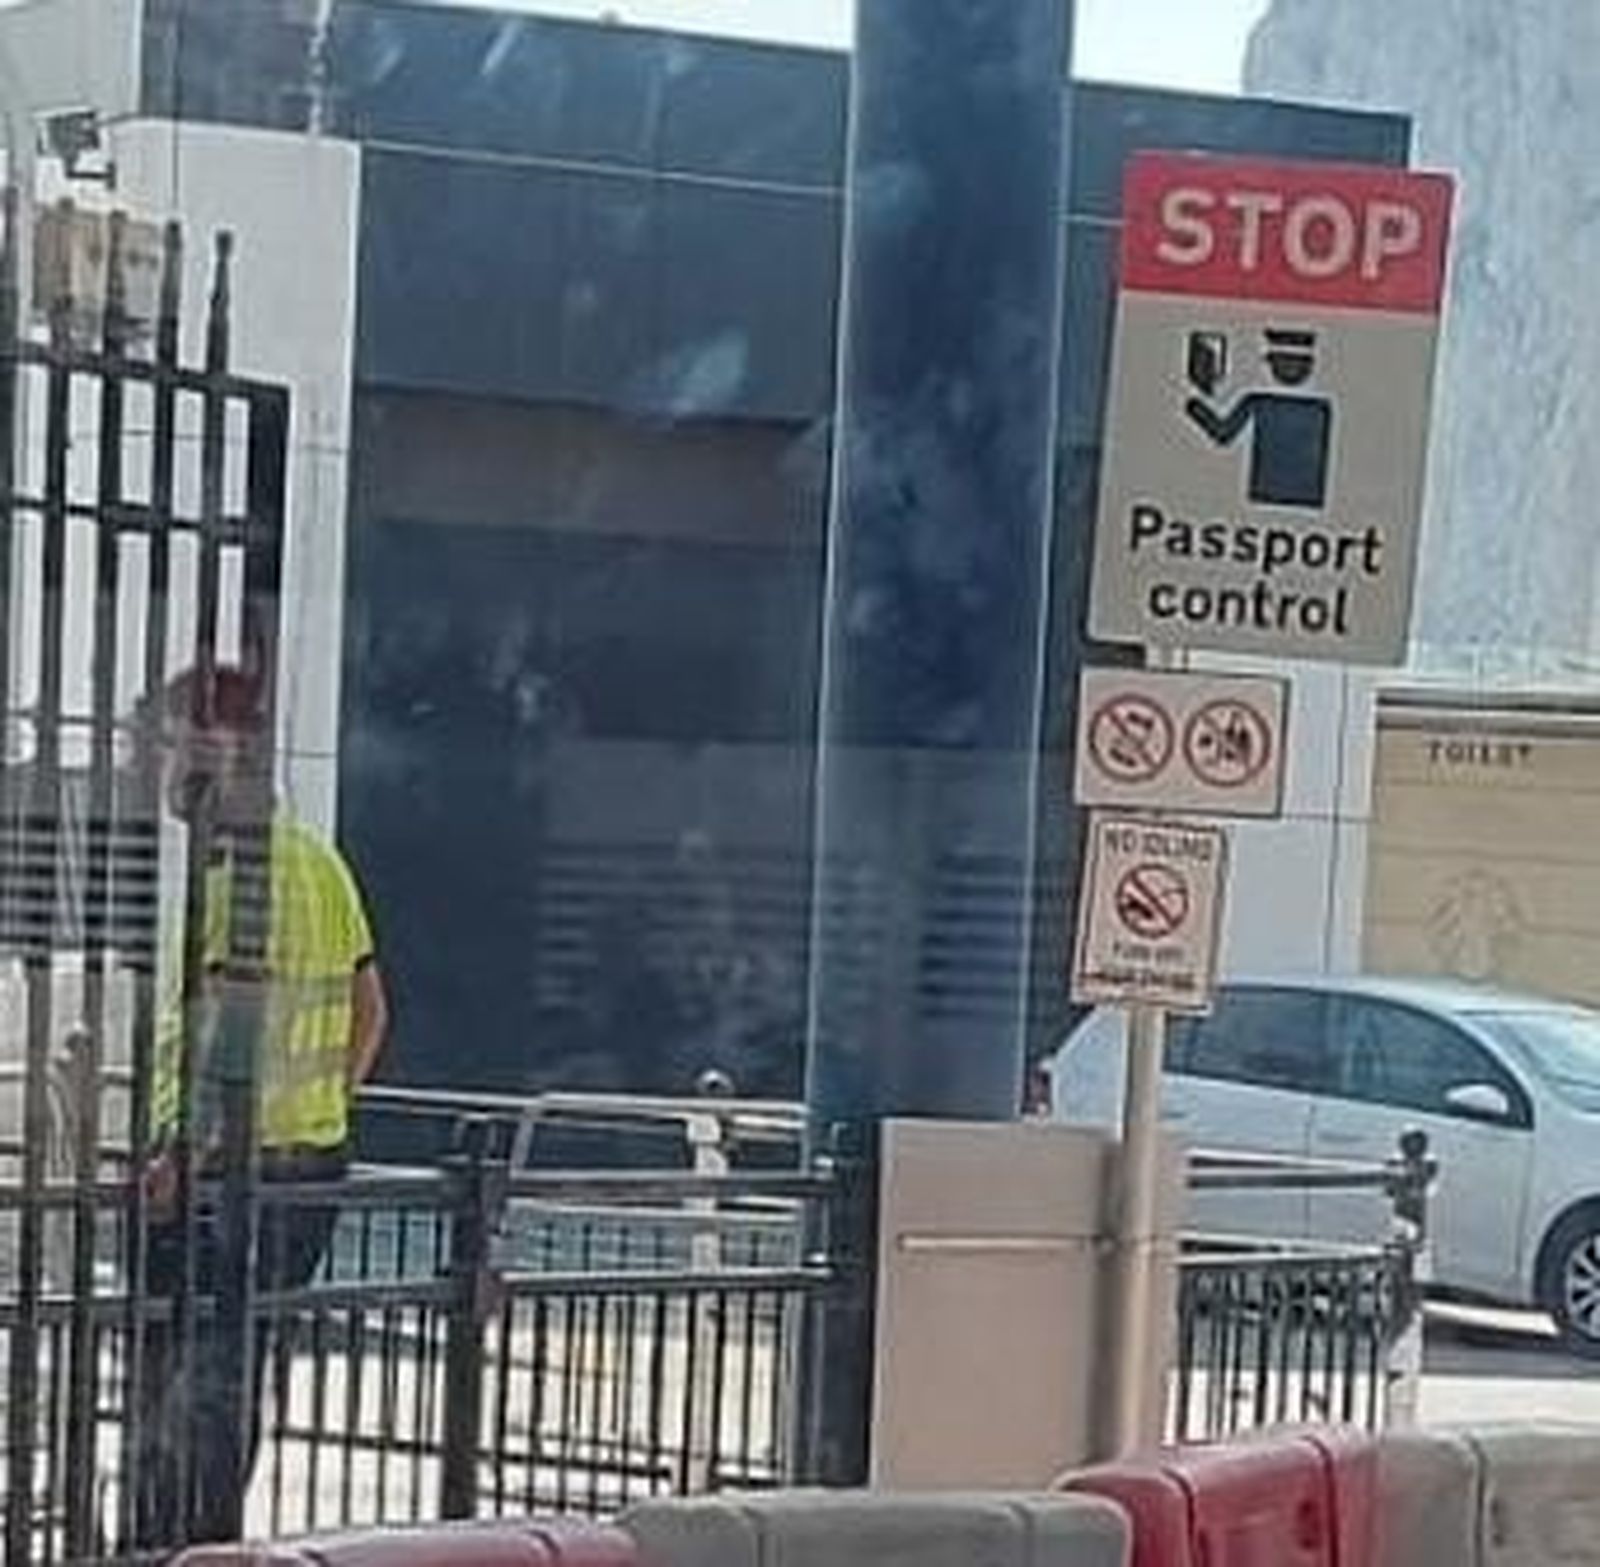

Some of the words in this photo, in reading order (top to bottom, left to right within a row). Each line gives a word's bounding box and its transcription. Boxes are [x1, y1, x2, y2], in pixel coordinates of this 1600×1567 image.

[1157, 188, 1422, 280] STOP
[1129, 505, 1383, 575] Passport
[1148, 580, 1348, 635] control
[1105, 829, 1137, 854] NO
